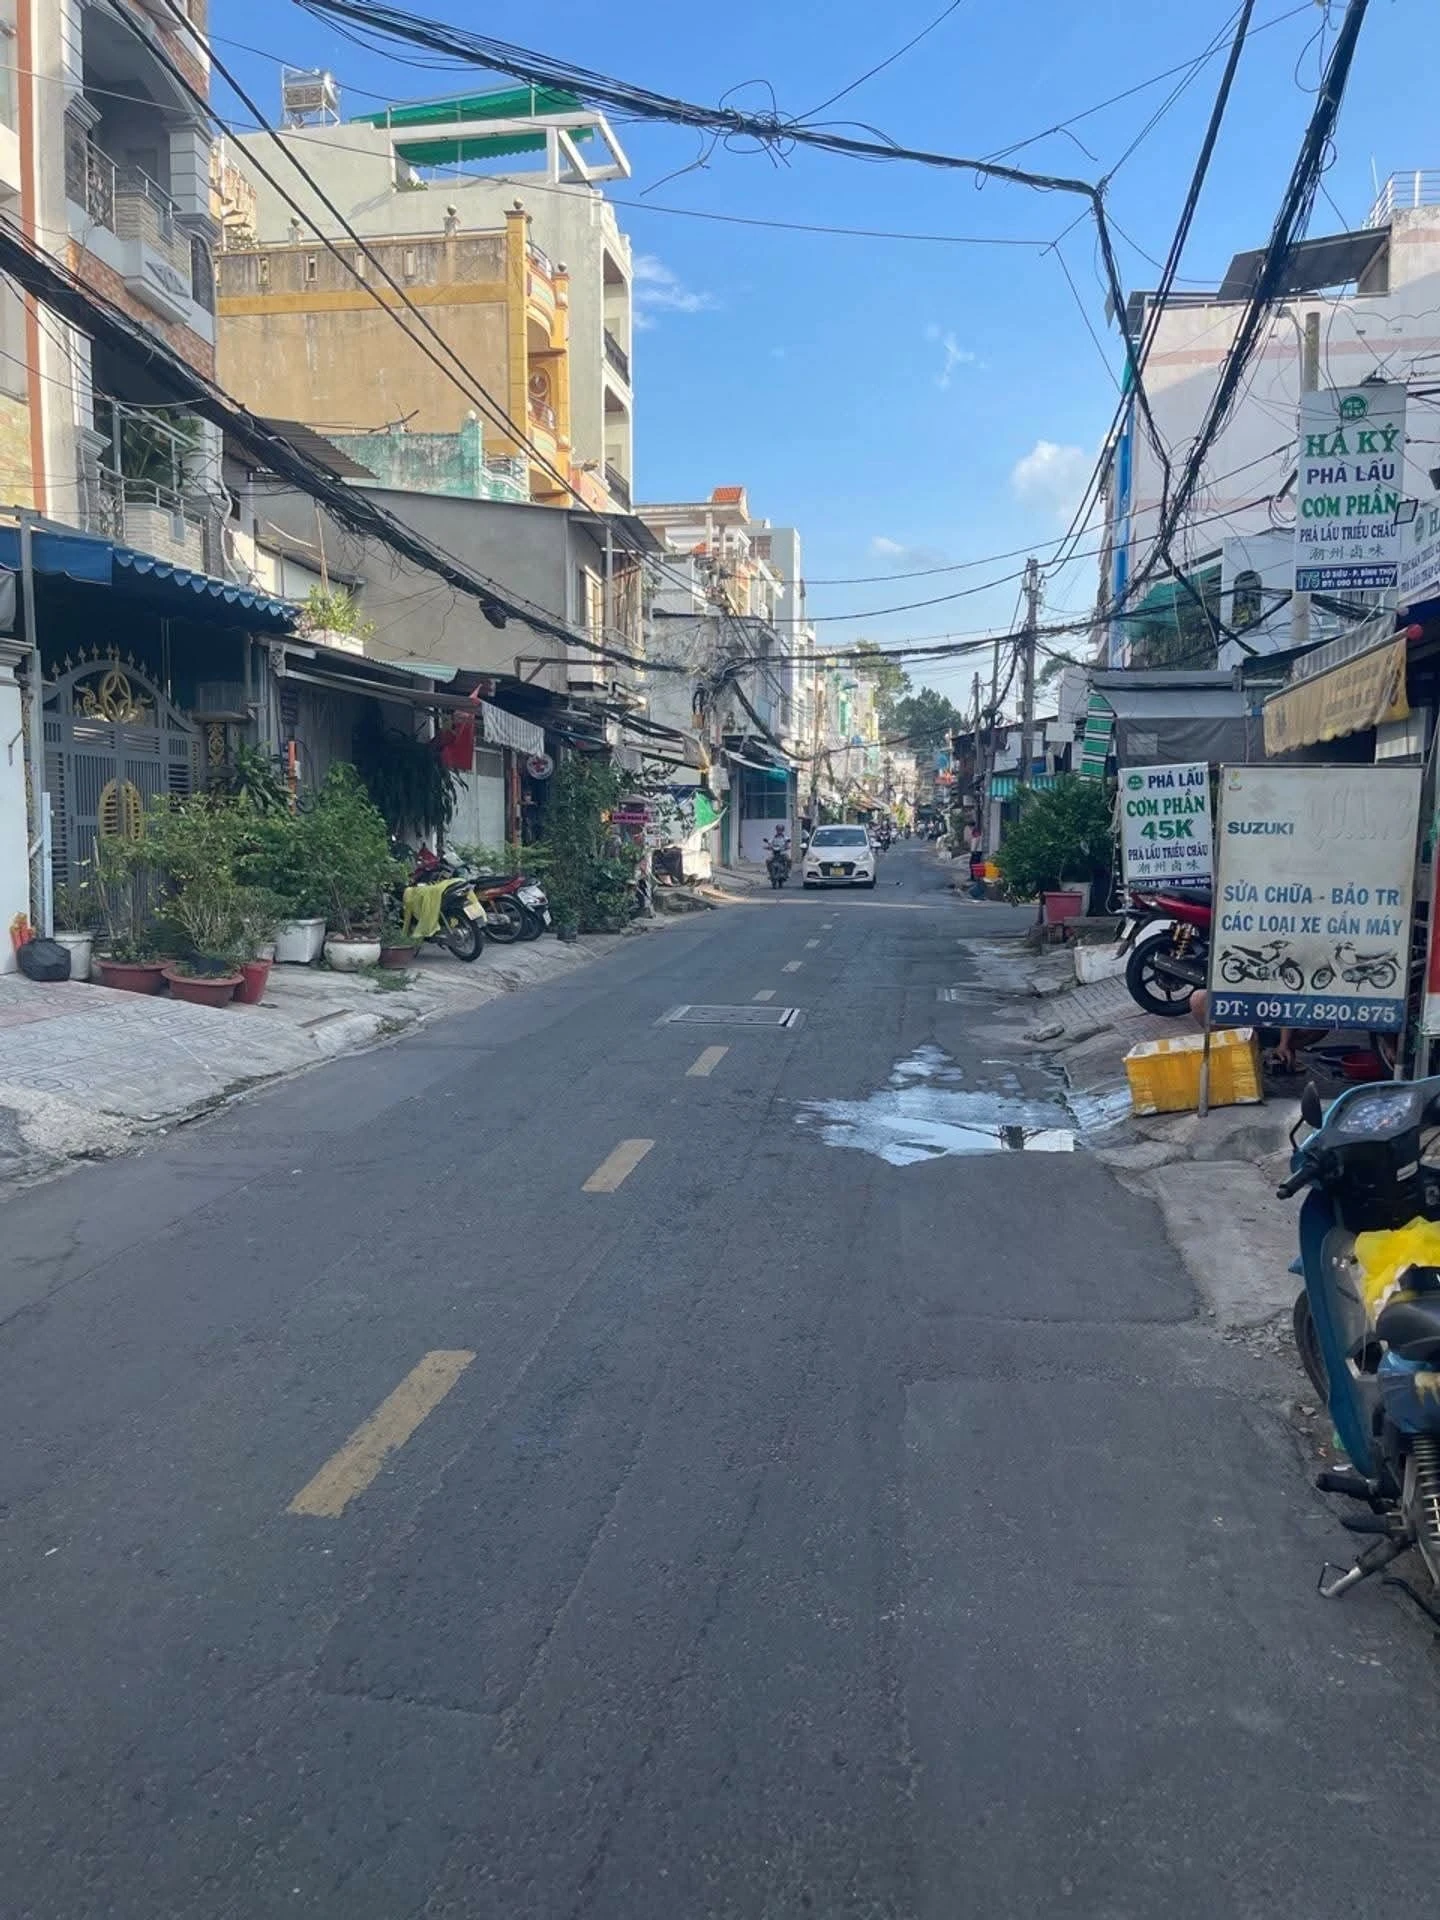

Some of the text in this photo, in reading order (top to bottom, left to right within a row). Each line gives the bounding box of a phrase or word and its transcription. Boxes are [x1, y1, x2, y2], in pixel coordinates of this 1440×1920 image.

[1357, 423, 1400, 454] KÝ
[1356, 457, 1395, 482] LẤU
[1302, 484, 1398, 518] CƠM PHẦN
[1321, 521, 1339, 541] LẤU
[1371, 521, 1396, 538] CHÂU
[1179, 767, 1204, 787] LẤU
[1127, 788, 1205, 817] CƠM PHẦN
[1141, 818, 1194, 841] 45K
[1227, 821, 1294, 836] SUZUKI
[1223, 879, 1258, 903] SỬA
[1265, 883, 1313, 904] CHỮA
[1332, 882, 1368, 906] BẢO
[1222, 910, 1403, 937] CÁC LOẠI XE GẮN MÁY
[1215, 1000, 1396, 1023] ĐT: 0917.820.875
